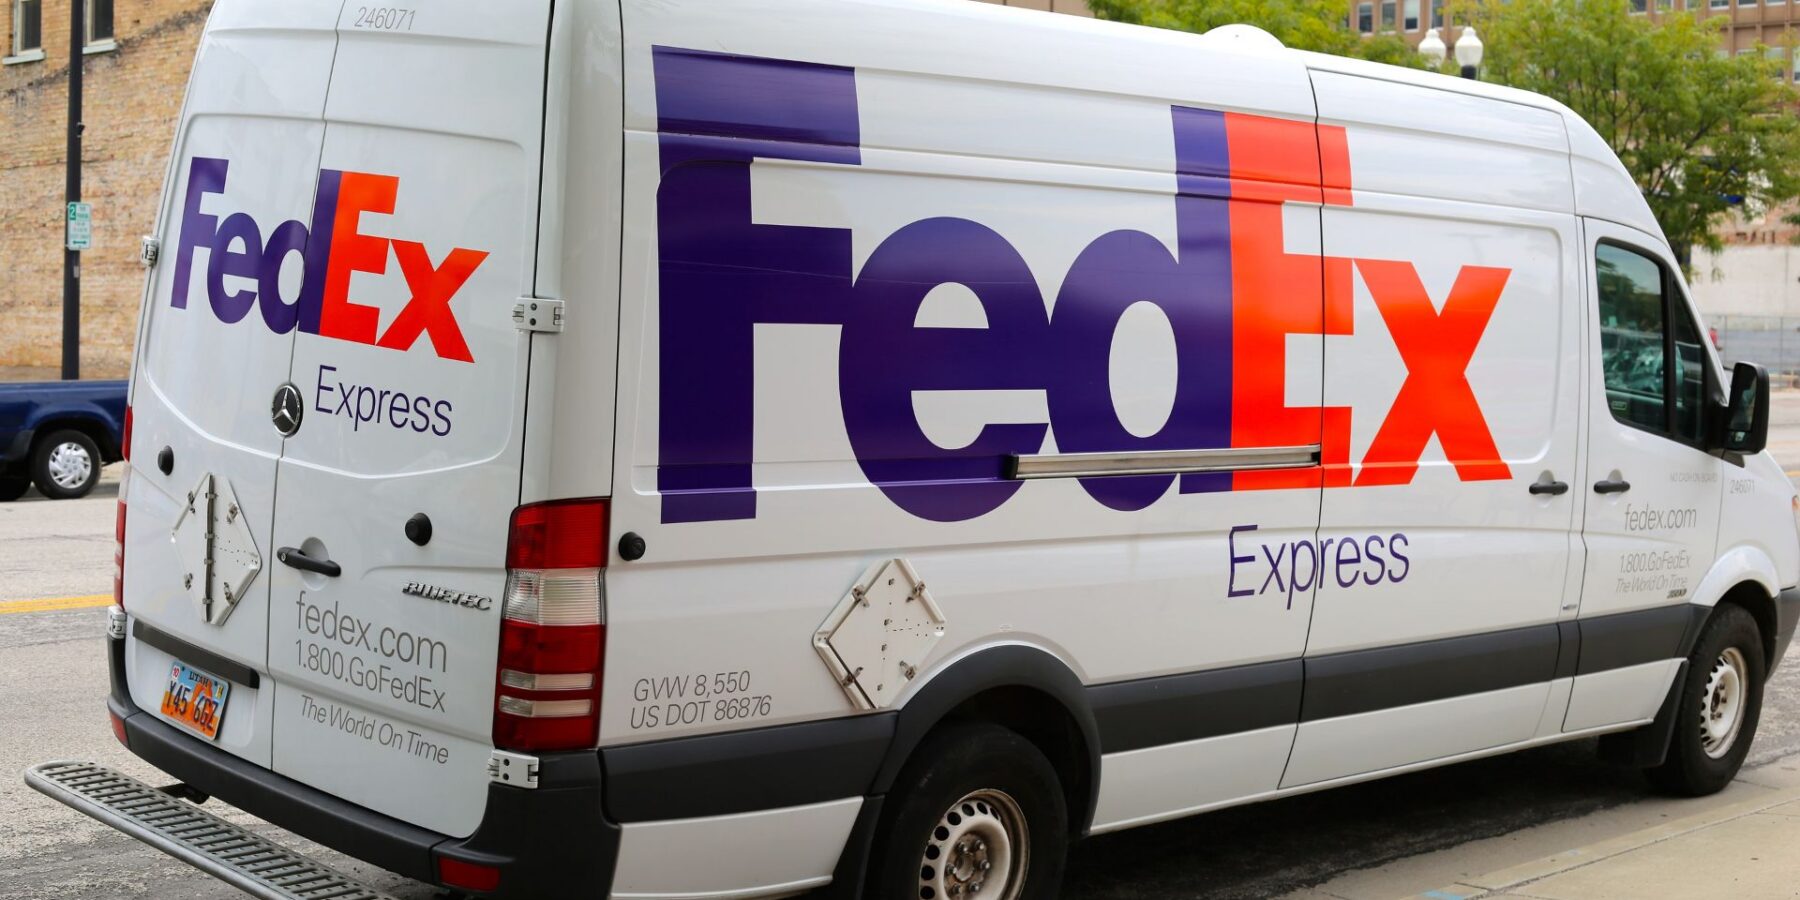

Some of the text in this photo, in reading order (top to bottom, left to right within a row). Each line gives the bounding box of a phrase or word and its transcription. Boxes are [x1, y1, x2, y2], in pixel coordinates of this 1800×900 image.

[354, 7, 416, 31] 246071
[170, 156, 490, 364] FedEx
[652, 45, 1513, 523] FedEx
[314, 364, 453, 437] Express
[1624, 501, 1697, 531] fedex.com
[1228, 524, 1410, 610] Express
[1620, 549, 1691, 573] 1.800.GoFedEx
[296, 591, 447, 672] fedex.com
[296, 639, 446, 713] 1.800.GoFedEx
[630, 695, 772, 729] US DOT 86876
[634, 670, 751, 702] GVW 8,550
[301, 694, 449, 765] The World On Time
